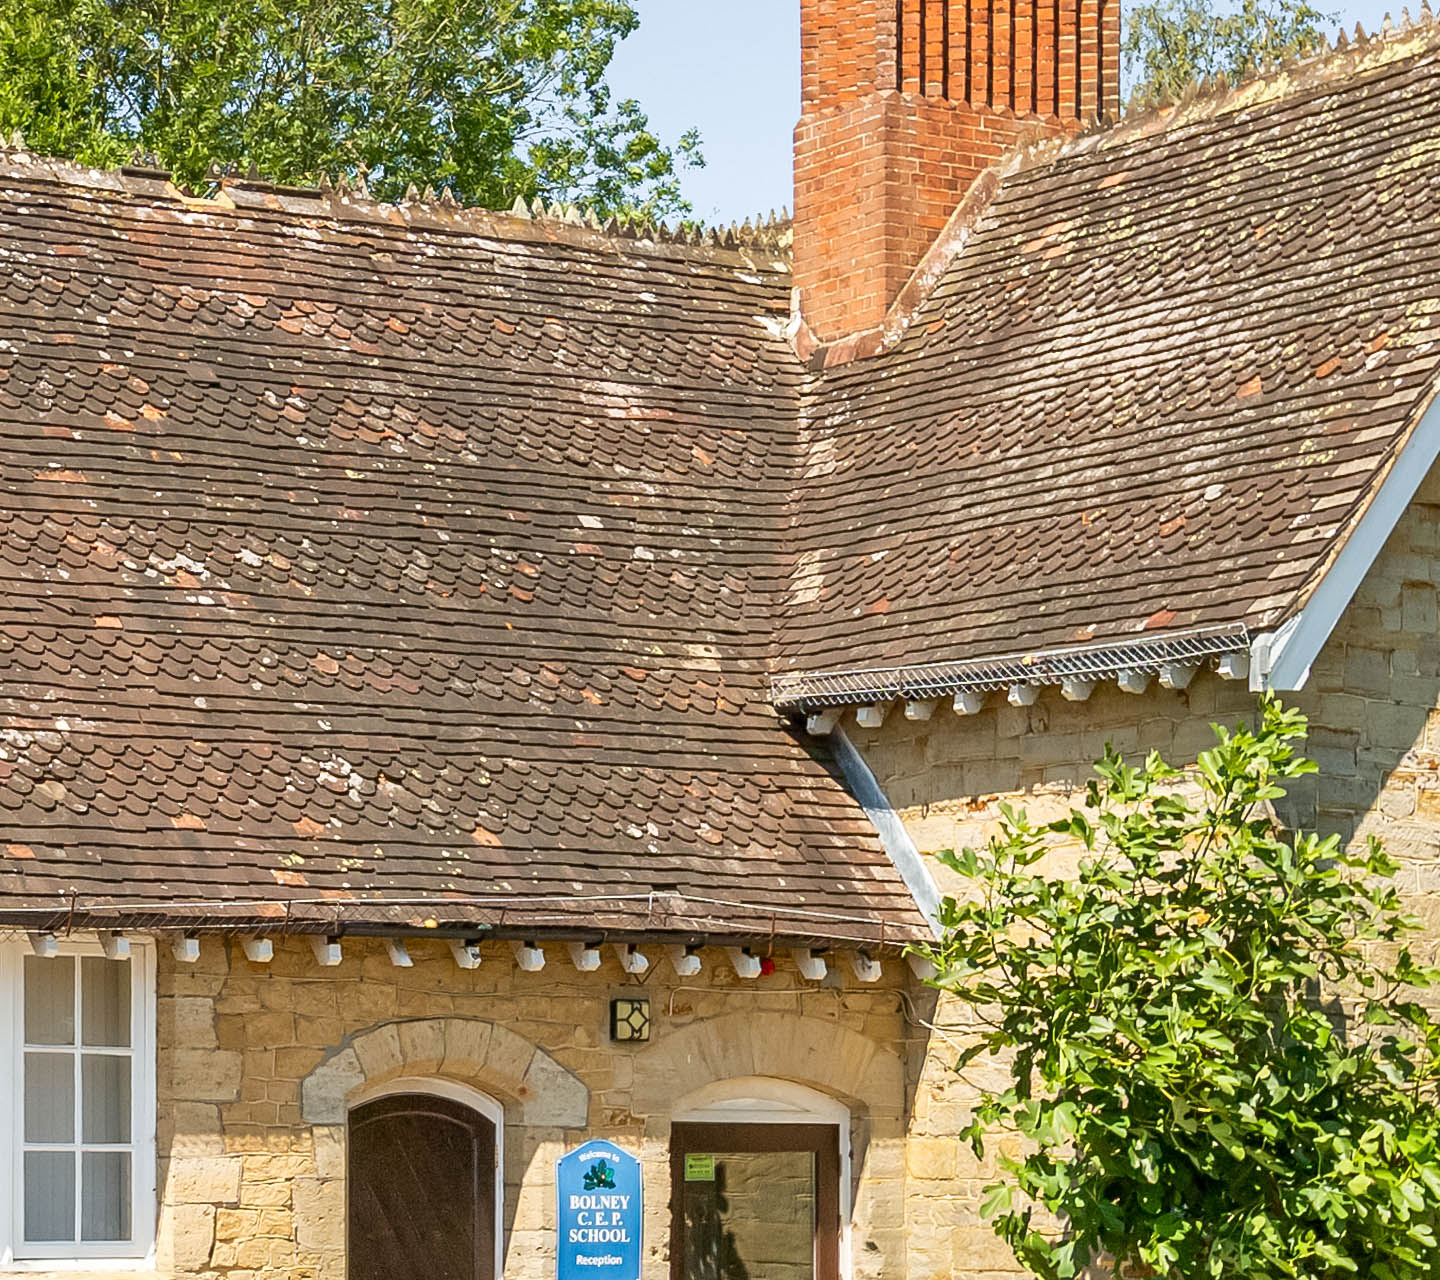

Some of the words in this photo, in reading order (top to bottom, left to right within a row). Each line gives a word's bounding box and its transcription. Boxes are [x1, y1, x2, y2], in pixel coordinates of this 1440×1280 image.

[578, 1151, 611, 1162] Welcome
[569, 1195, 630, 1210] BOLNEY
[577, 1212, 592, 1226] C.
[595, 1212, 608, 1226] E.
[612, 1212, 623, 1226] P.
[569, 1228, 630, 1243] SCHOOL
[576, 1255, 622, 1267] Reception
